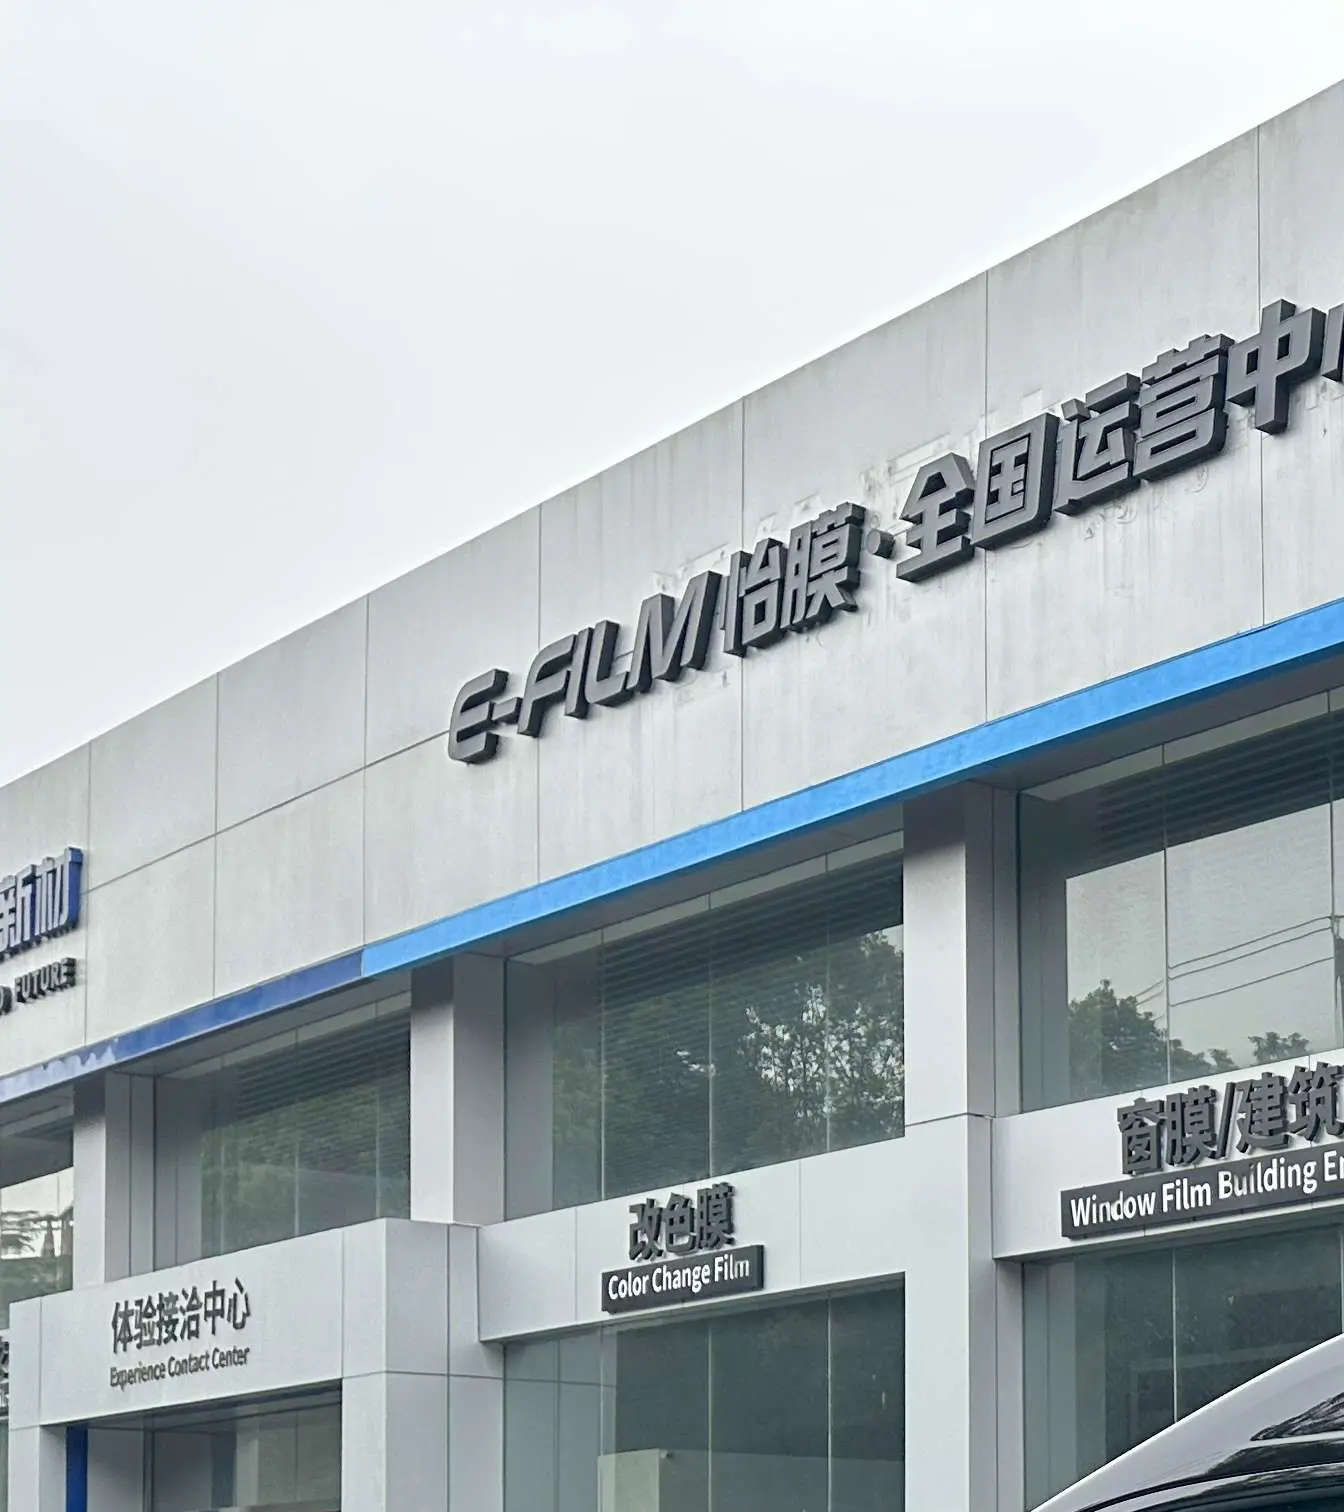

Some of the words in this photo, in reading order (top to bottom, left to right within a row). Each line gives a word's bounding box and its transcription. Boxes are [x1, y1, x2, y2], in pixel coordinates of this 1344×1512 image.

[15, 957, 76, 1003] FUTURE
[629, 1182, 736, 1261] 改色膜
[1070, 1188, 1156, 1228] Window
[1161, 1177, 1211, 1213] Film
[1218, 1156, 1316, 1199] Building
[608, 1271, 649, 1300] Color
[652, 1264, 711, 1293] Change
[714, 1254, 750, 1282] Film
[111, 1277, 251, 1354] 体验接洽中心
[110, 1361, 166, 1392] Experience
[168, 1352, 210, 1378] Contact
[211, 1347, 250, 1369] Center
